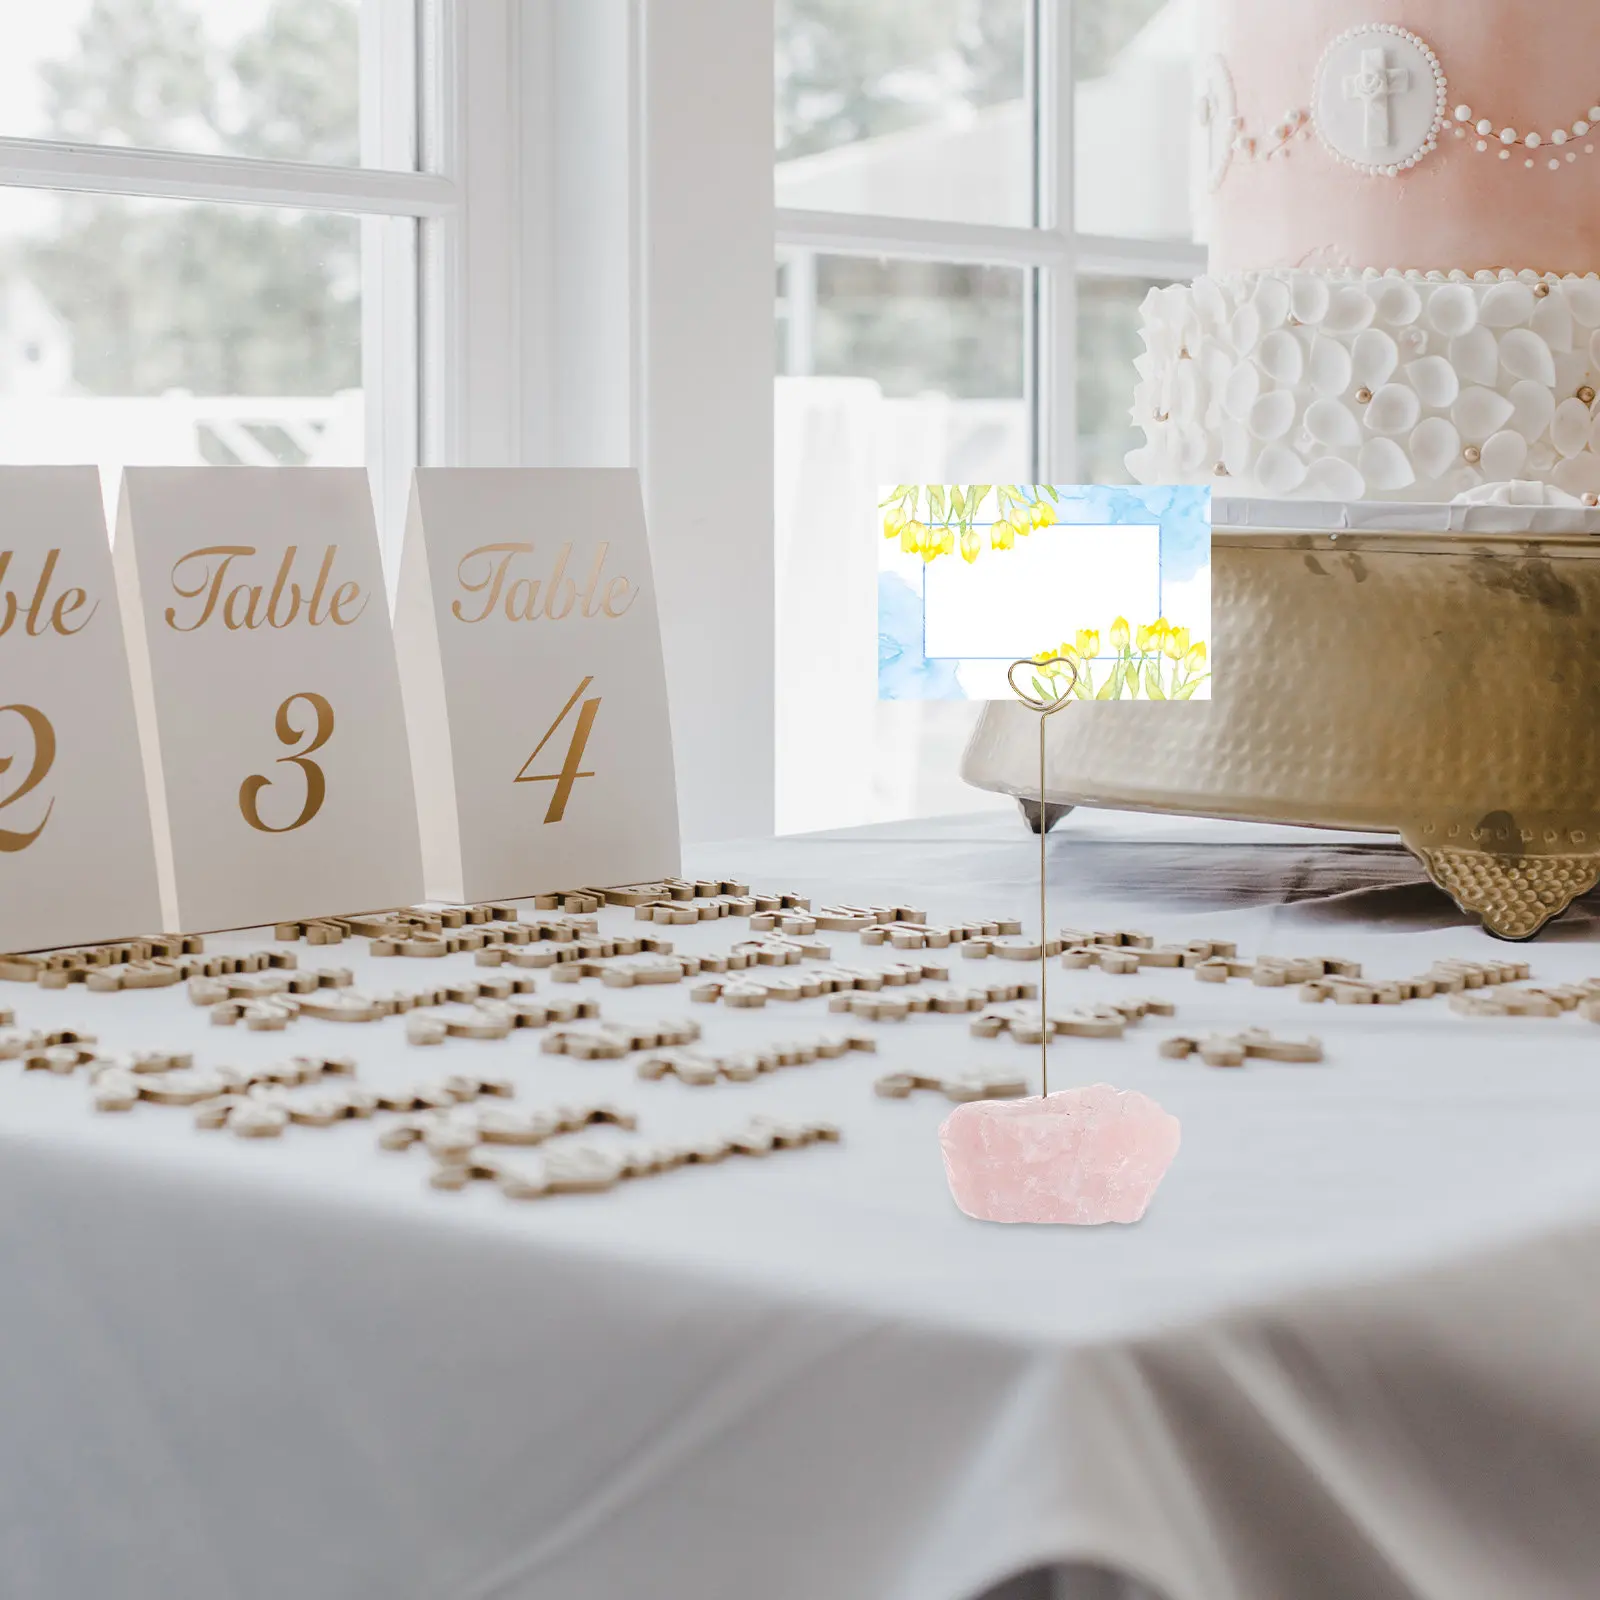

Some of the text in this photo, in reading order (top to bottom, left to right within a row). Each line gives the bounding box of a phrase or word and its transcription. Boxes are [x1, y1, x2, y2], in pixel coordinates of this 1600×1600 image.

[164, 544, 371, 633] Table
[451, 541, 640, 623] Table
[0, 704, 57, 853] 2
[238, 692, 335, 833] 3
[513, 675, 603, 825] 4
